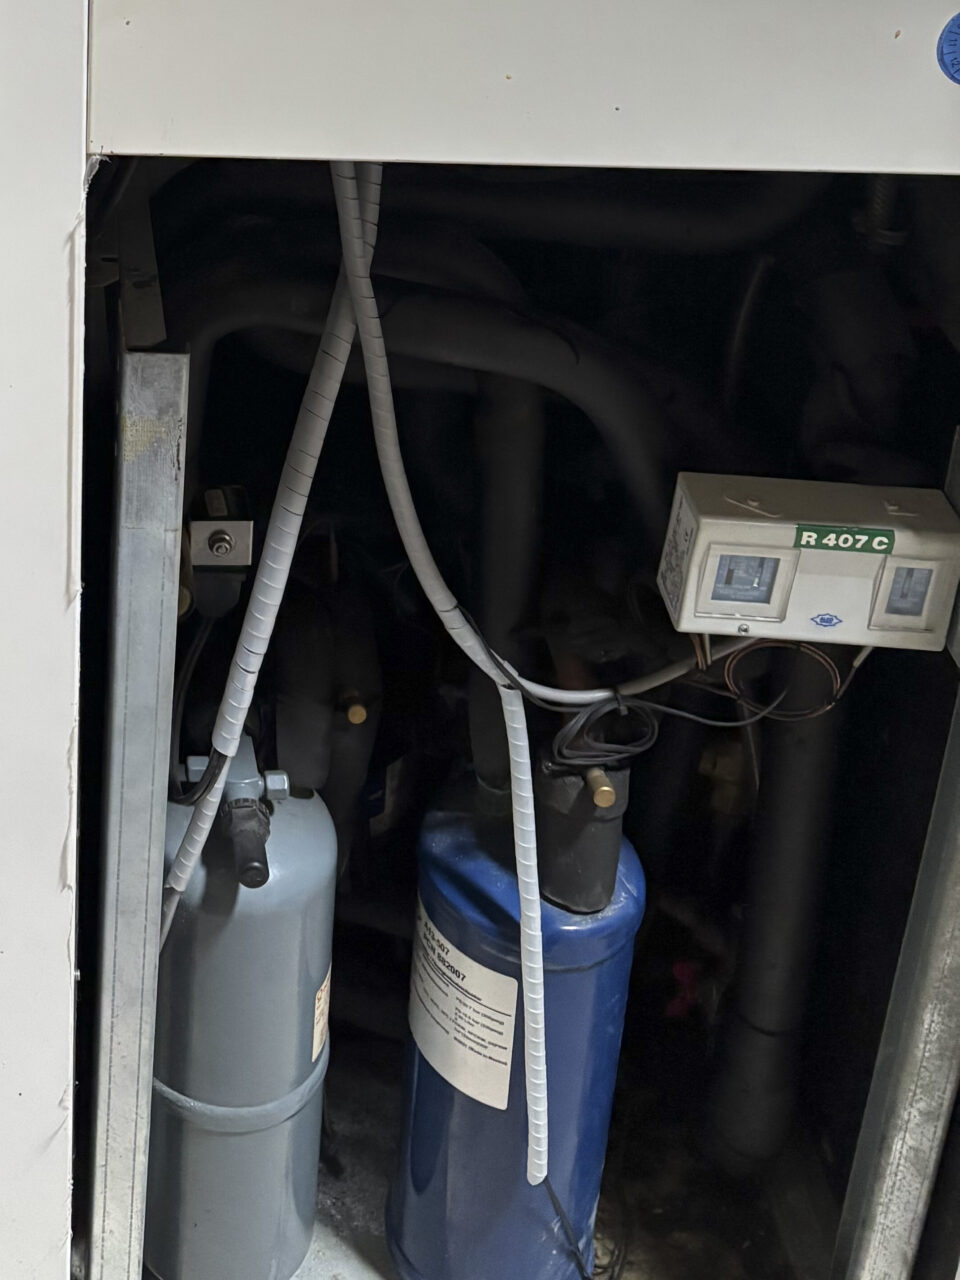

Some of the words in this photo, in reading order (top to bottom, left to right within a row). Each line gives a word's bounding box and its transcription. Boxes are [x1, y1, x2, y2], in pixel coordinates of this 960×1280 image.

[800, 531, 818, 546] R
[822, 533, 869, 549] 407
[872, 535, 889, 550] C
